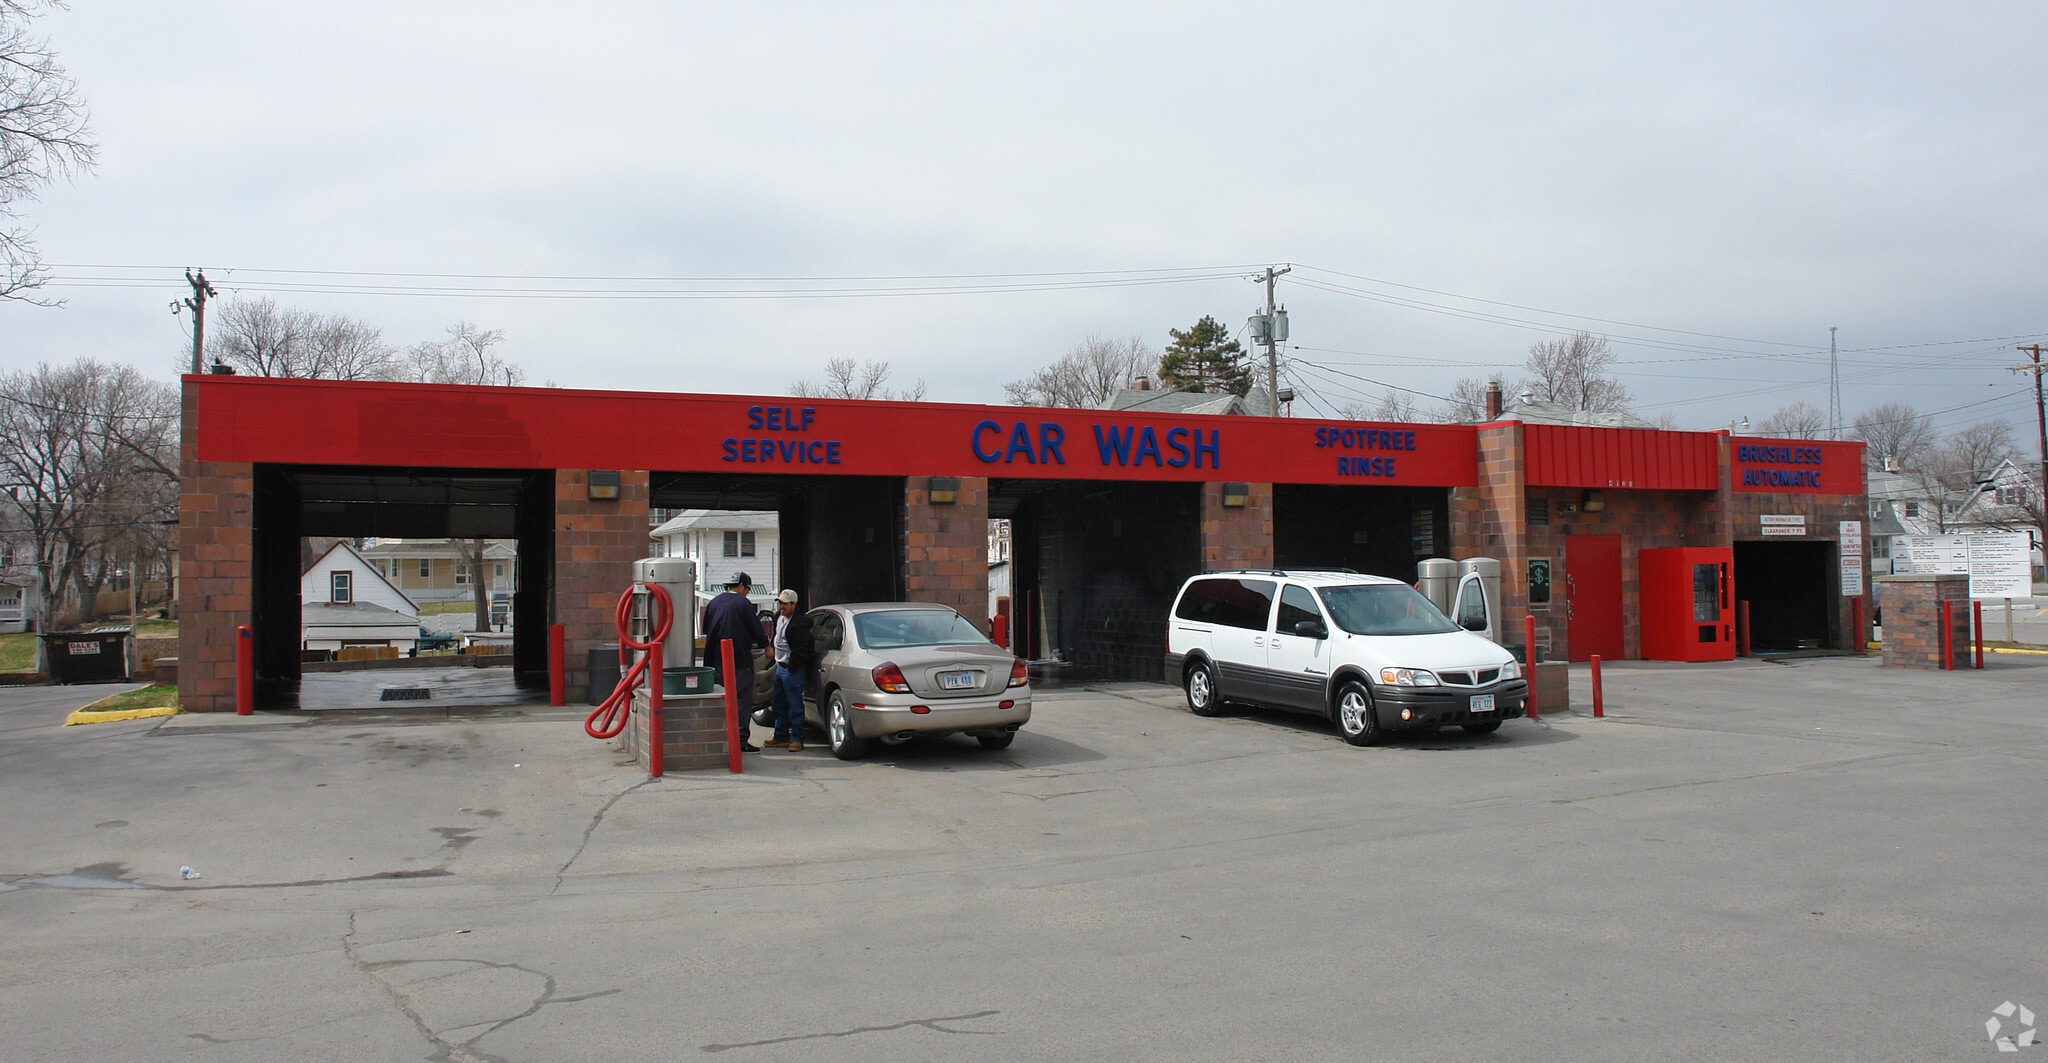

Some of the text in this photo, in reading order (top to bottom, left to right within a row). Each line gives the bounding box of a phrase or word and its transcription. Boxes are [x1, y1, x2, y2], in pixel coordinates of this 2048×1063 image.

[748, 406, 816, 431] SELF
[971, 420, 1220, 469] CAR WASH
[1315, 427, 1416, 450] SPOTFREE
[722, 438, 841, 464] SERVICE
[1739, 445, 1822, 464] BRUSHLESS
[1337, 456, 1395, 476] RINSE
[1743, 469, 1821, 487] AUTOMATIC
[649, 569, 655, 578] 4
[688, 567, 693, 576] 4
